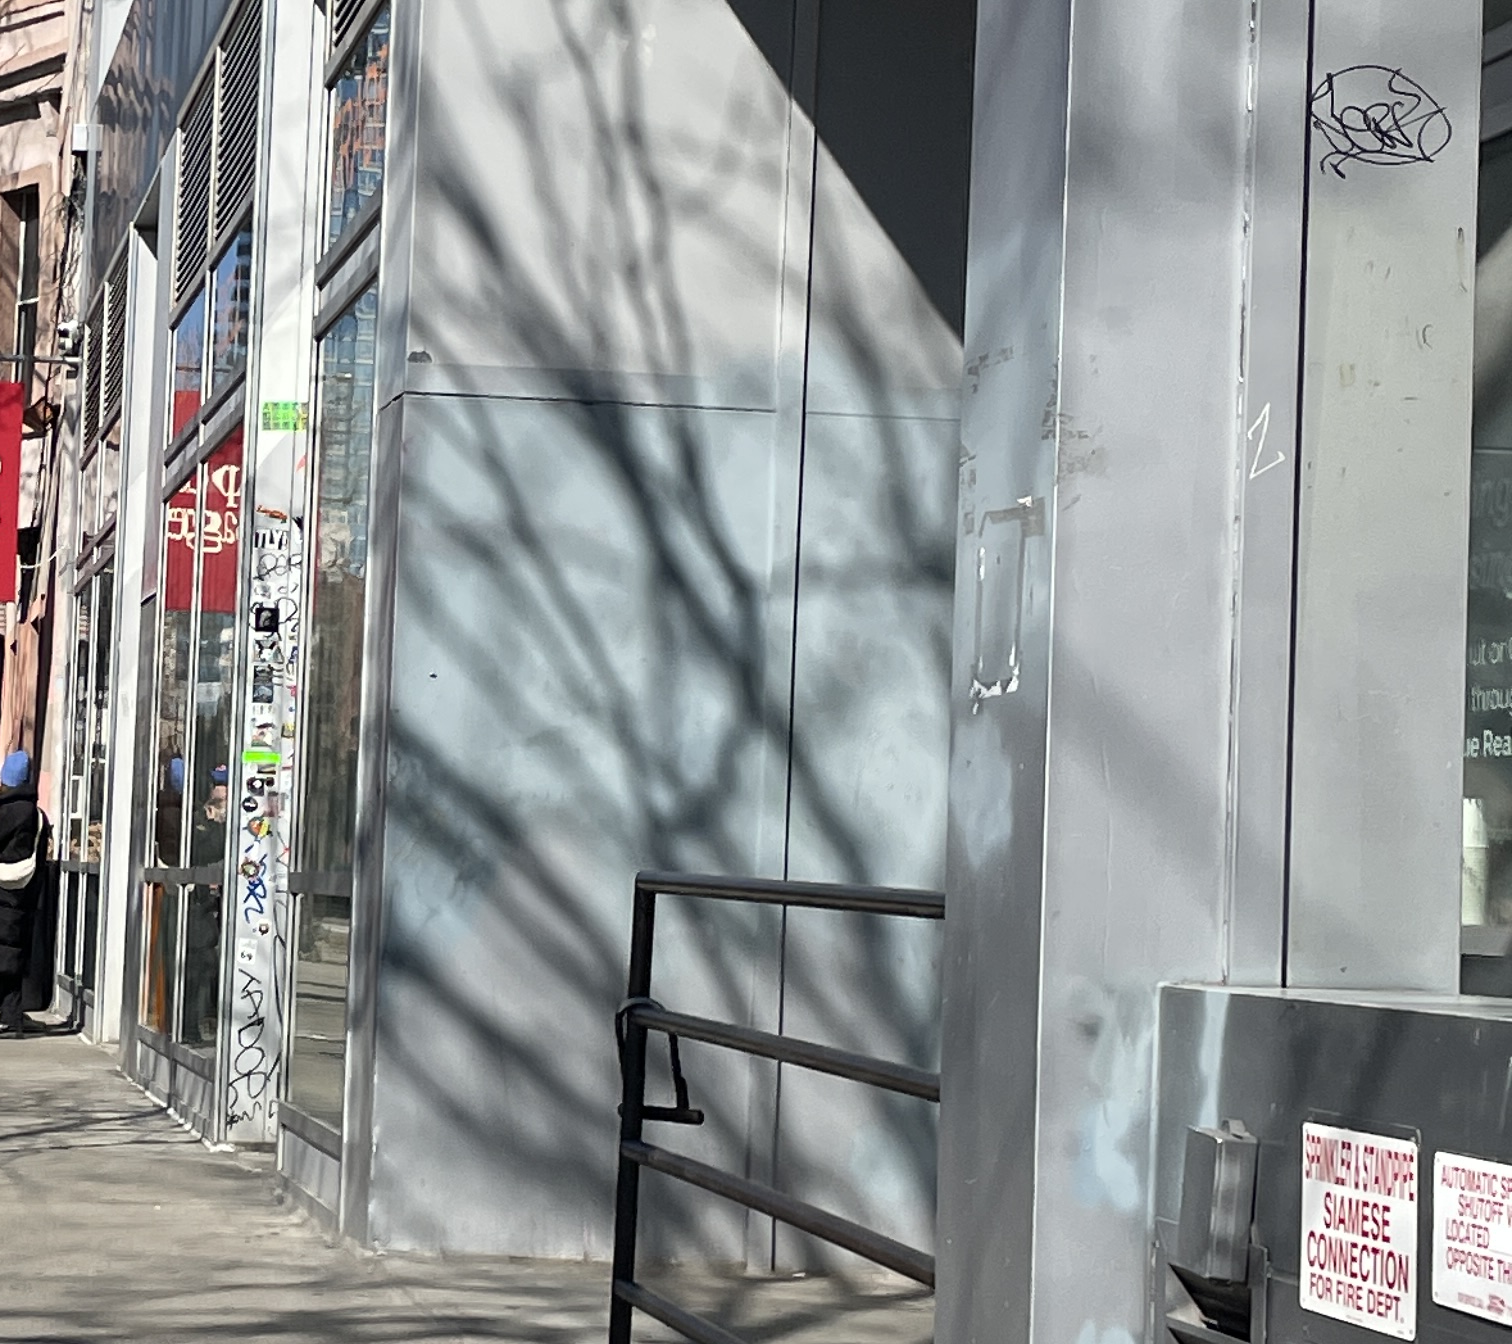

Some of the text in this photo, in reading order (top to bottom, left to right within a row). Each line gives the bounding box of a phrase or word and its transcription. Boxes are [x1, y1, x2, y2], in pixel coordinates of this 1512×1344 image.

[1305, 1133, 1414, 1201] SPRINKLER & STANDPIPE
[1441, 1164, 1498, 1198] AUTOMATIC
[1323, 1191, 1391, 1244] SIAMESE
[1457, 1193, 1505, 1225] SHUTOFF
[1445, 1216, 1491, 1250] LOCATED
[1306, 1230, 1410, 1294] CONNECTION
[1446, 1246, 1495, 1281] OPPOSITE
[1309, 1272, 1405, 1324] FOR FIRE DEPT.
